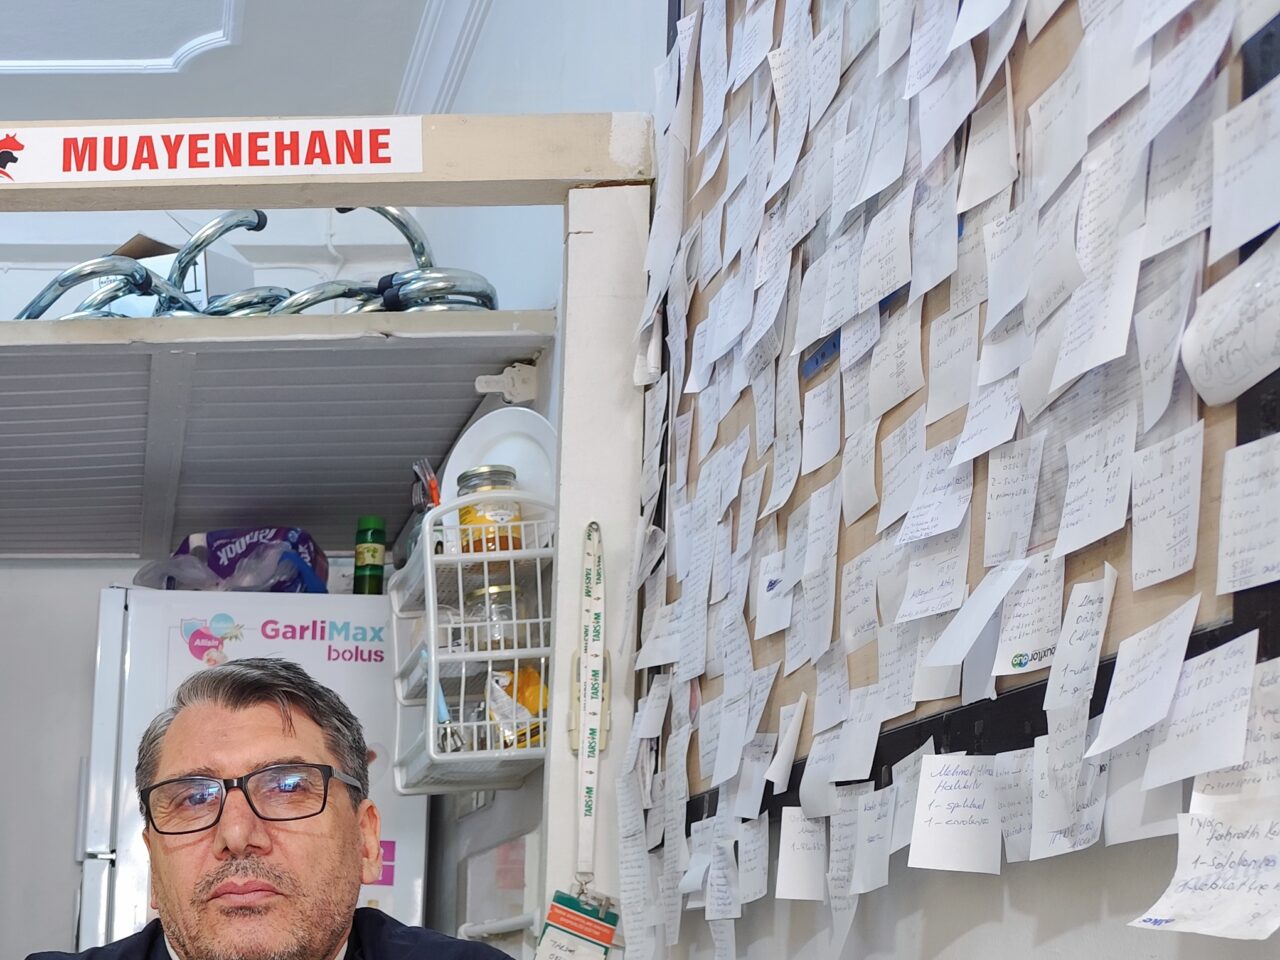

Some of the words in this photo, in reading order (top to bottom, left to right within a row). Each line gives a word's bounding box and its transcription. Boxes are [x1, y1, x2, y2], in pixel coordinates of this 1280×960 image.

[61, 128, 392, 173] MUAYENEHANE
[260, 619, 385, 643] GarliMax
[326, 645, 385, 663] bolus
